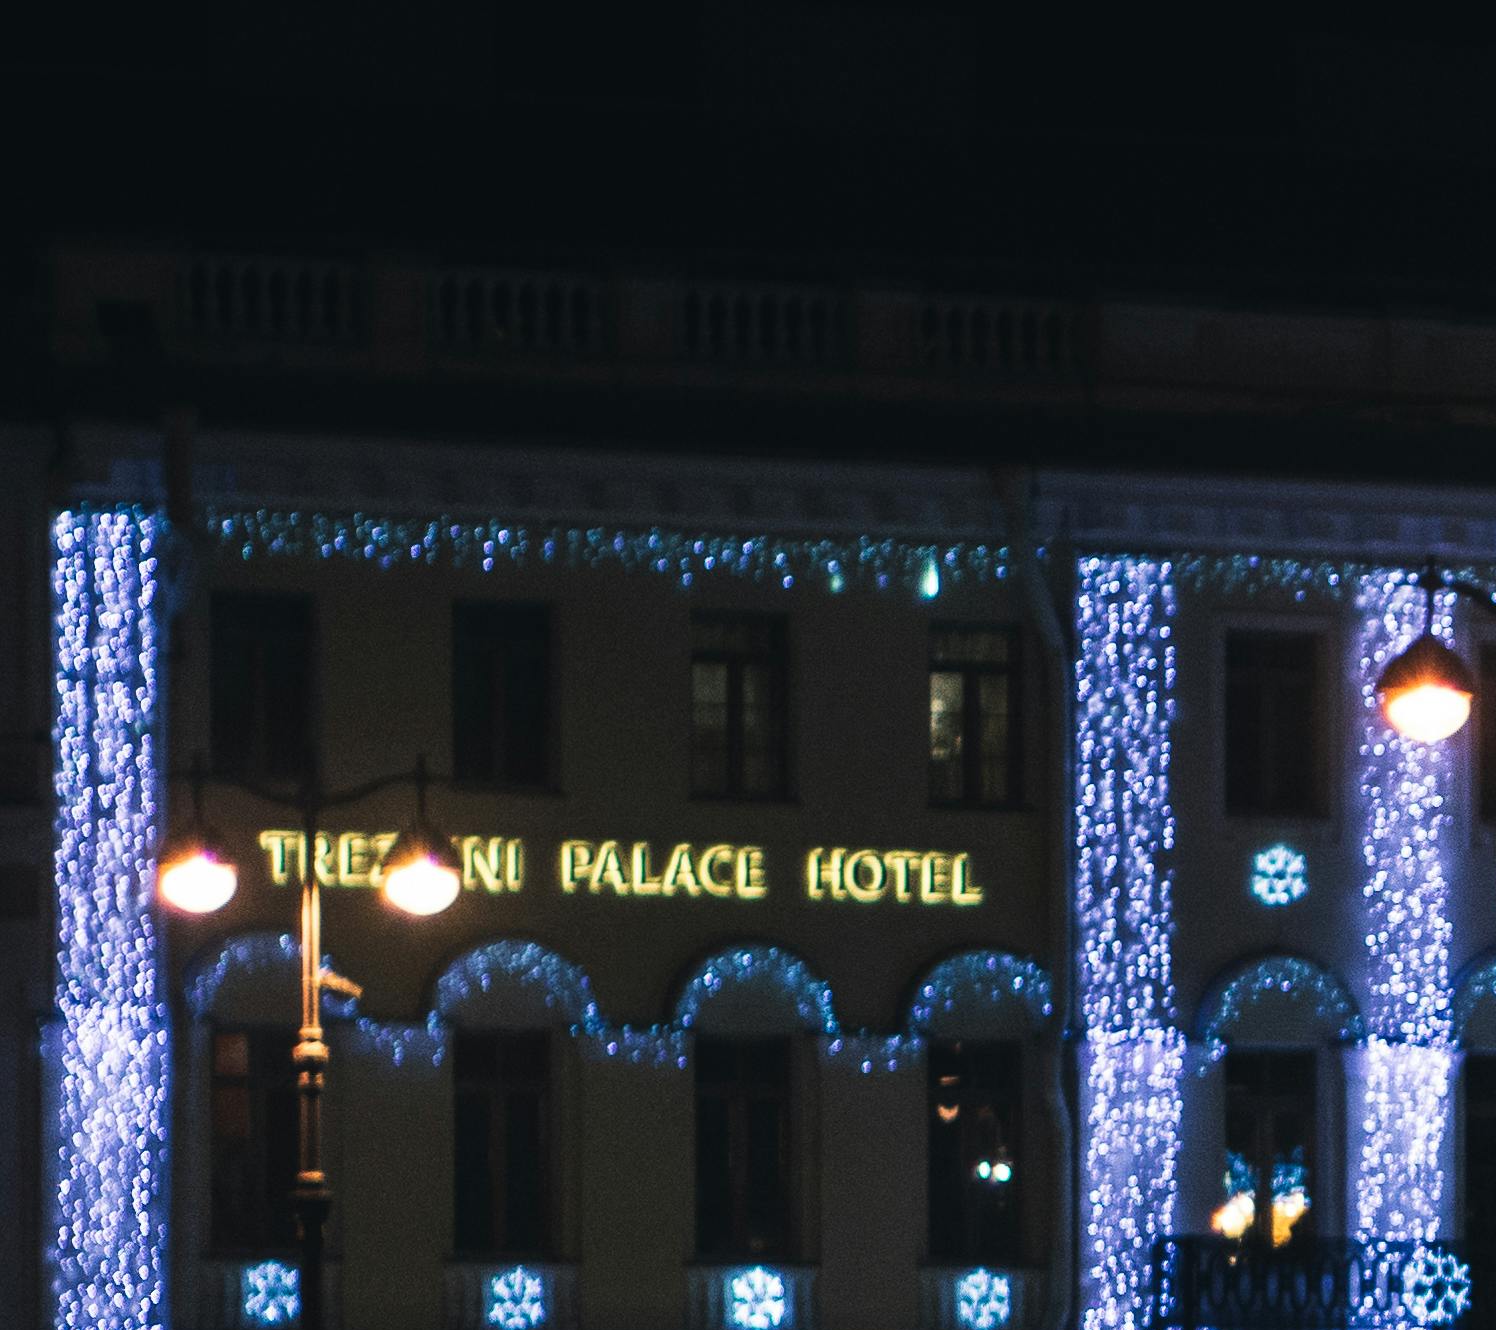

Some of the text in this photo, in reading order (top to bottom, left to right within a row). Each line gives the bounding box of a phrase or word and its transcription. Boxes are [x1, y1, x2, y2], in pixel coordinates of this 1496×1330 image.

[259, 830, 983, 905] TREZNI PALACE HOTEL
